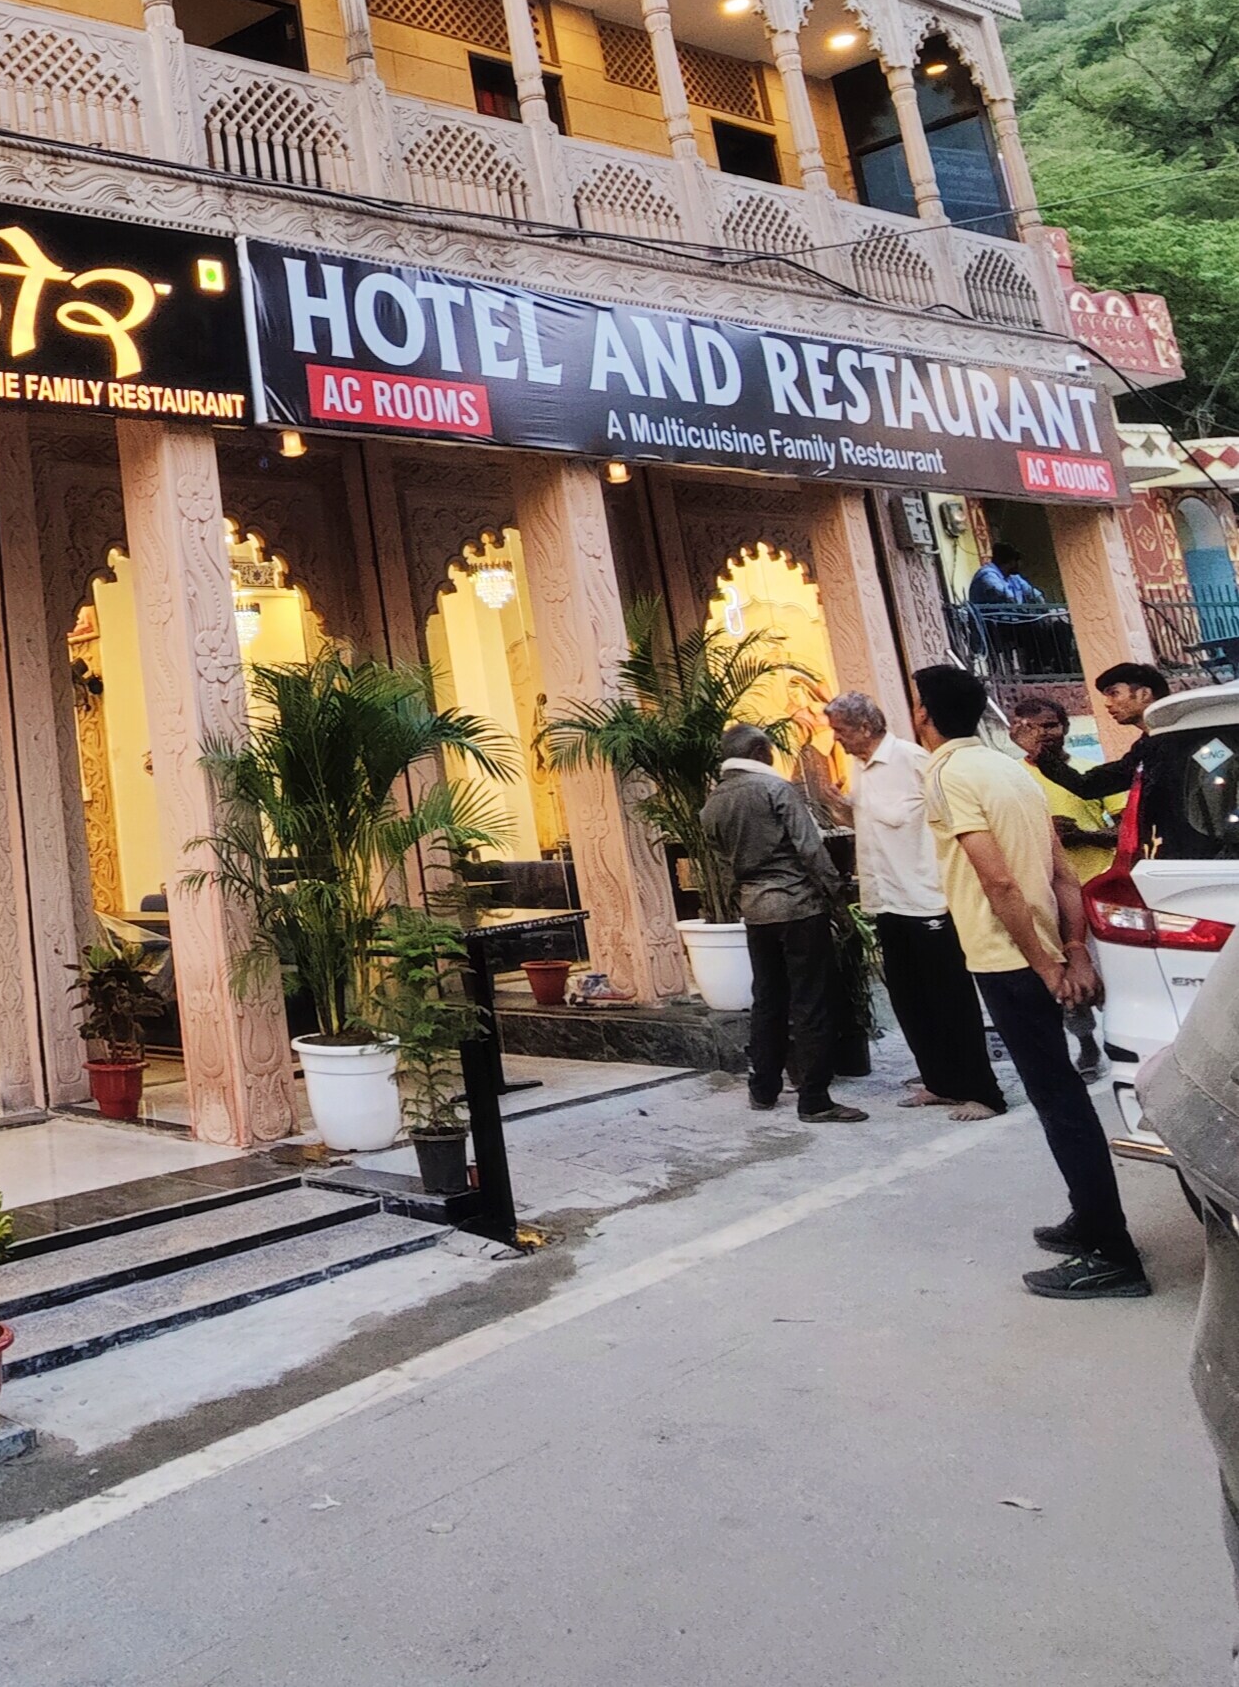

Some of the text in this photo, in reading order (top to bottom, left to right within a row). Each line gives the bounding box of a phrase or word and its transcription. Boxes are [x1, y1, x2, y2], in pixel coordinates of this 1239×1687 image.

[282, 257, 1103, 454] HOTEL AND RESTAURANT
[25, 374, 103, 406] FAMILY
[108, 382, 245, 419] RESTAURANT
[322, 374, 481, 427] AC ROOMS
[607, 410, 947, 475] A Multicuisine Family Restaurant
[1026, 457, 1110, 493] AC ROOMS
